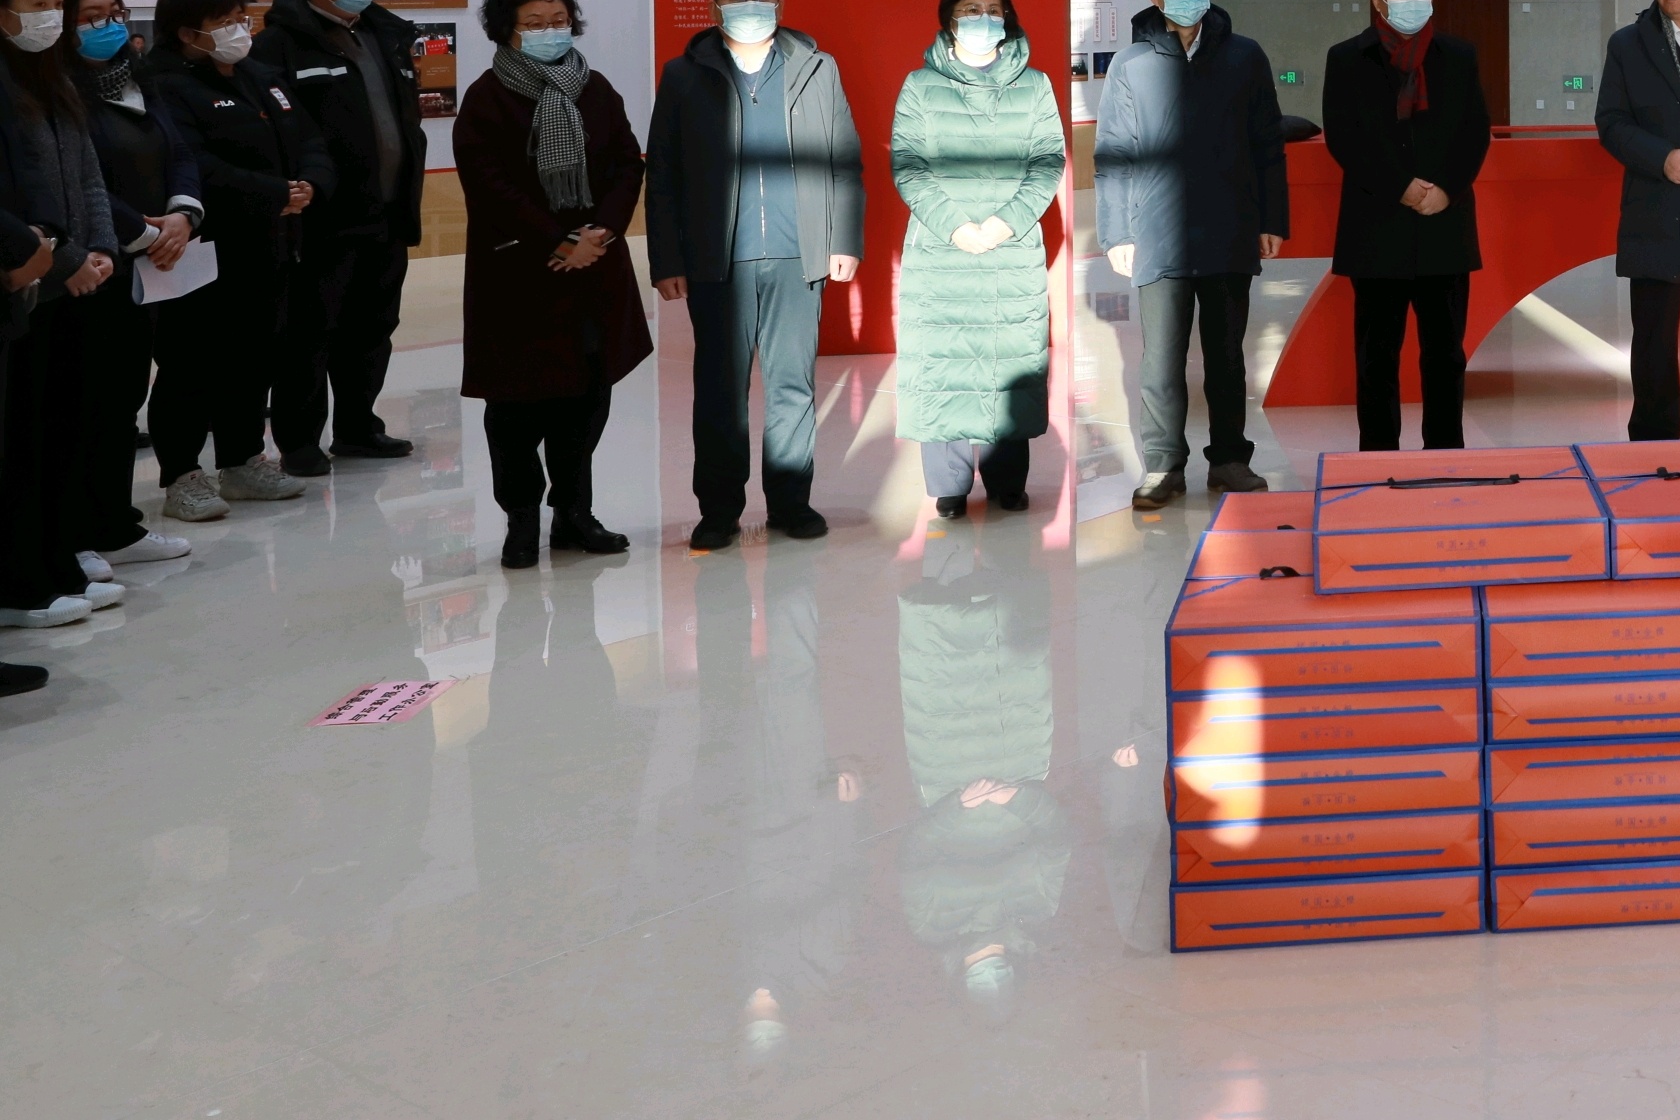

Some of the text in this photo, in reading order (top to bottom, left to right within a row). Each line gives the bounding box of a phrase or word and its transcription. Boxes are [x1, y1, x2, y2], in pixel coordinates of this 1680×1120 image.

[213, 99, 236, 108] FILA
[378, 681, 440, 721] 工作办公室
